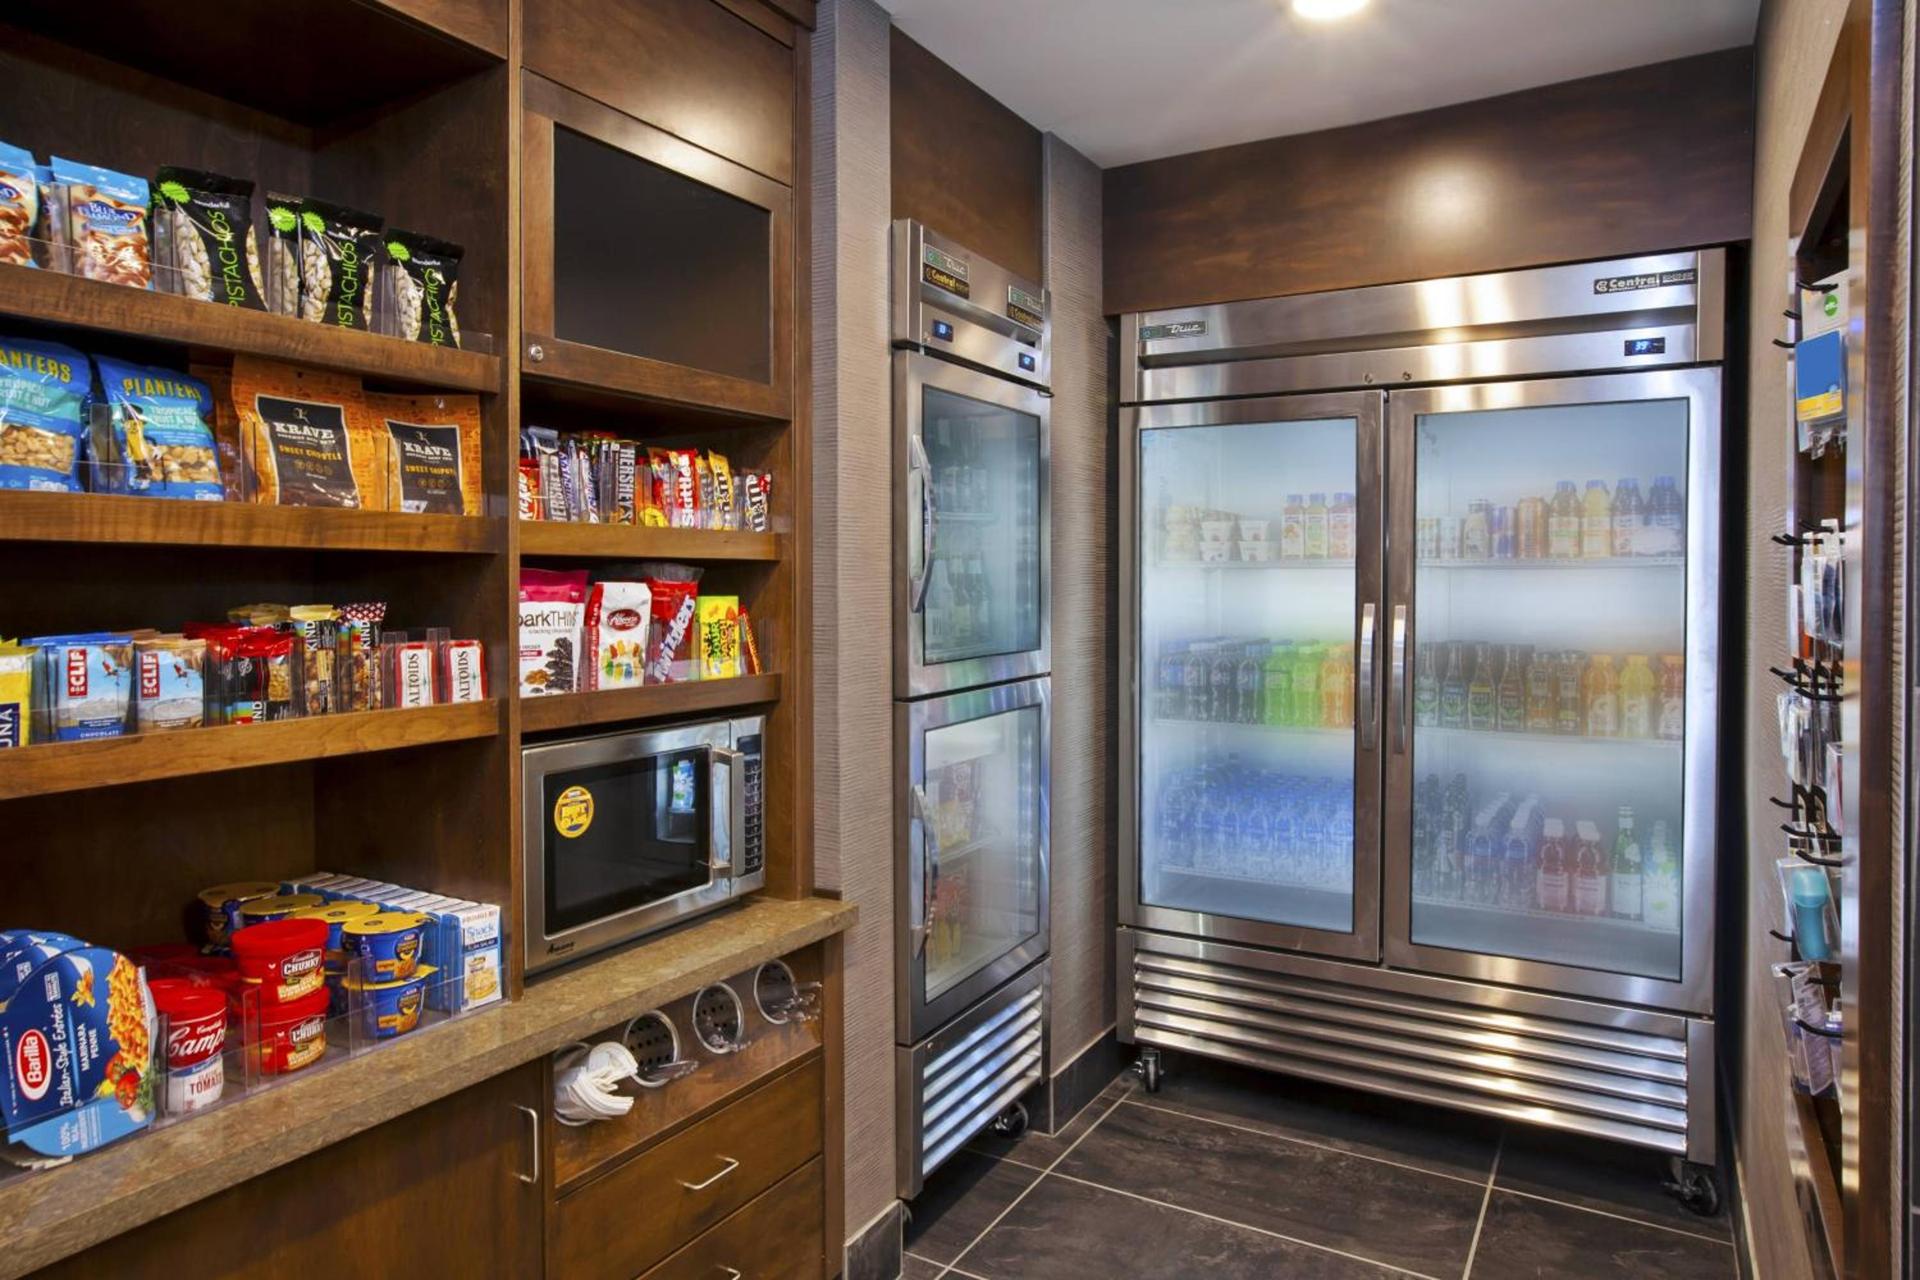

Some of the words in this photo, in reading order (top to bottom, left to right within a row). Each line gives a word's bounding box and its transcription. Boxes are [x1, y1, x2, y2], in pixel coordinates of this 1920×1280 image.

[1609, 273, 1660, 289] Central
[1166, 323, 1202, 334] True
[0, 350, 72, 384] ANTERS
[273, 421, 334, 440] KRAVE
[403, 441, 451, 457] KRAVE
[304, 620, 317, 652] KIND
[360, 620, 370, 650] KIND
[69, 651, 86, 684] CLIF
[143, 655, 157, 687] CLIF
[408, 653, 420, 705] ALTOIDS
[458, 650, 471, 701] ALTOIDS
[2, 708, 13, 747] UNA
[252, 701, 265, 723] IND
[283, 957, 320, 976] CHUNKY
[77, 1023, 91, 1072] MARINARA
[88, 1028, 100, 1059] PENNE
[168, 1026, 226, 1056] Camp
[23, 1035, 43, 1083] Barilla
[53, 1041, 74, 1107] Italian-Style
